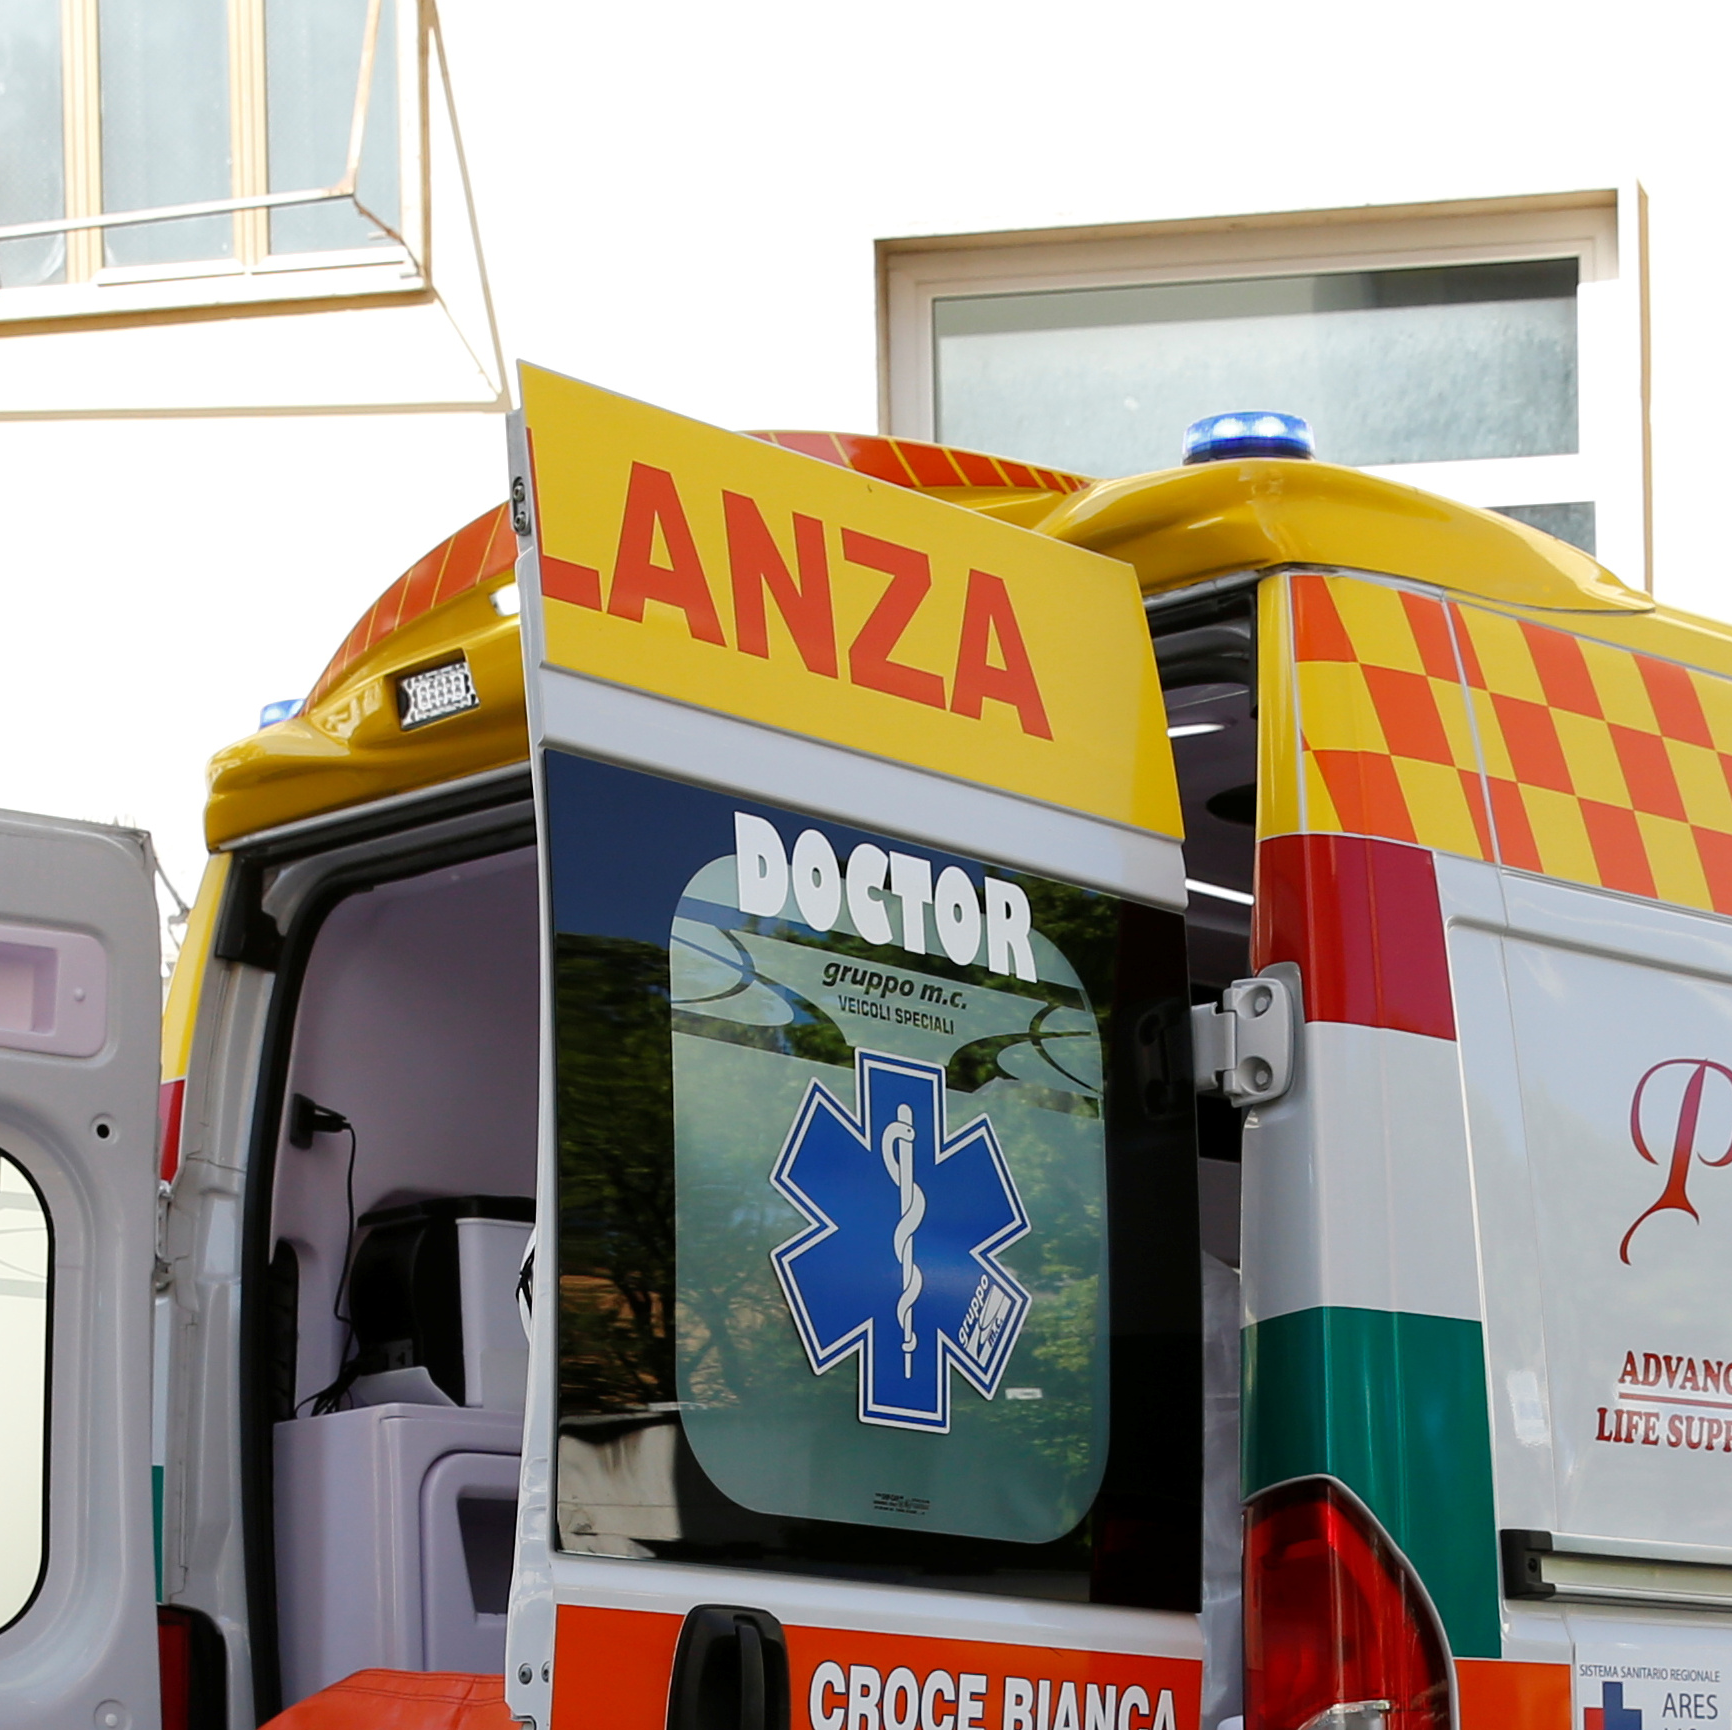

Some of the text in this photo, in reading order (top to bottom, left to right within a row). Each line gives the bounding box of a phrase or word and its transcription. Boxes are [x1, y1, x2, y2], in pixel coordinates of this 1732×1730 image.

[734, 811, 1038, 983] DOCTOR
[822, 962, 967, 1010] gruppo m.c.
[838, 995, 954, 1035] VEICOLI SPECIALI
[958, 1274, 988, 1348] gruppo
[1595, 1407, 1659, 1446] LIFE
[1579, 1664, 1720, 1682] SISTEMA SANITARIO REGIONALE
[1662, 1693, 1718, 1720] ARES
